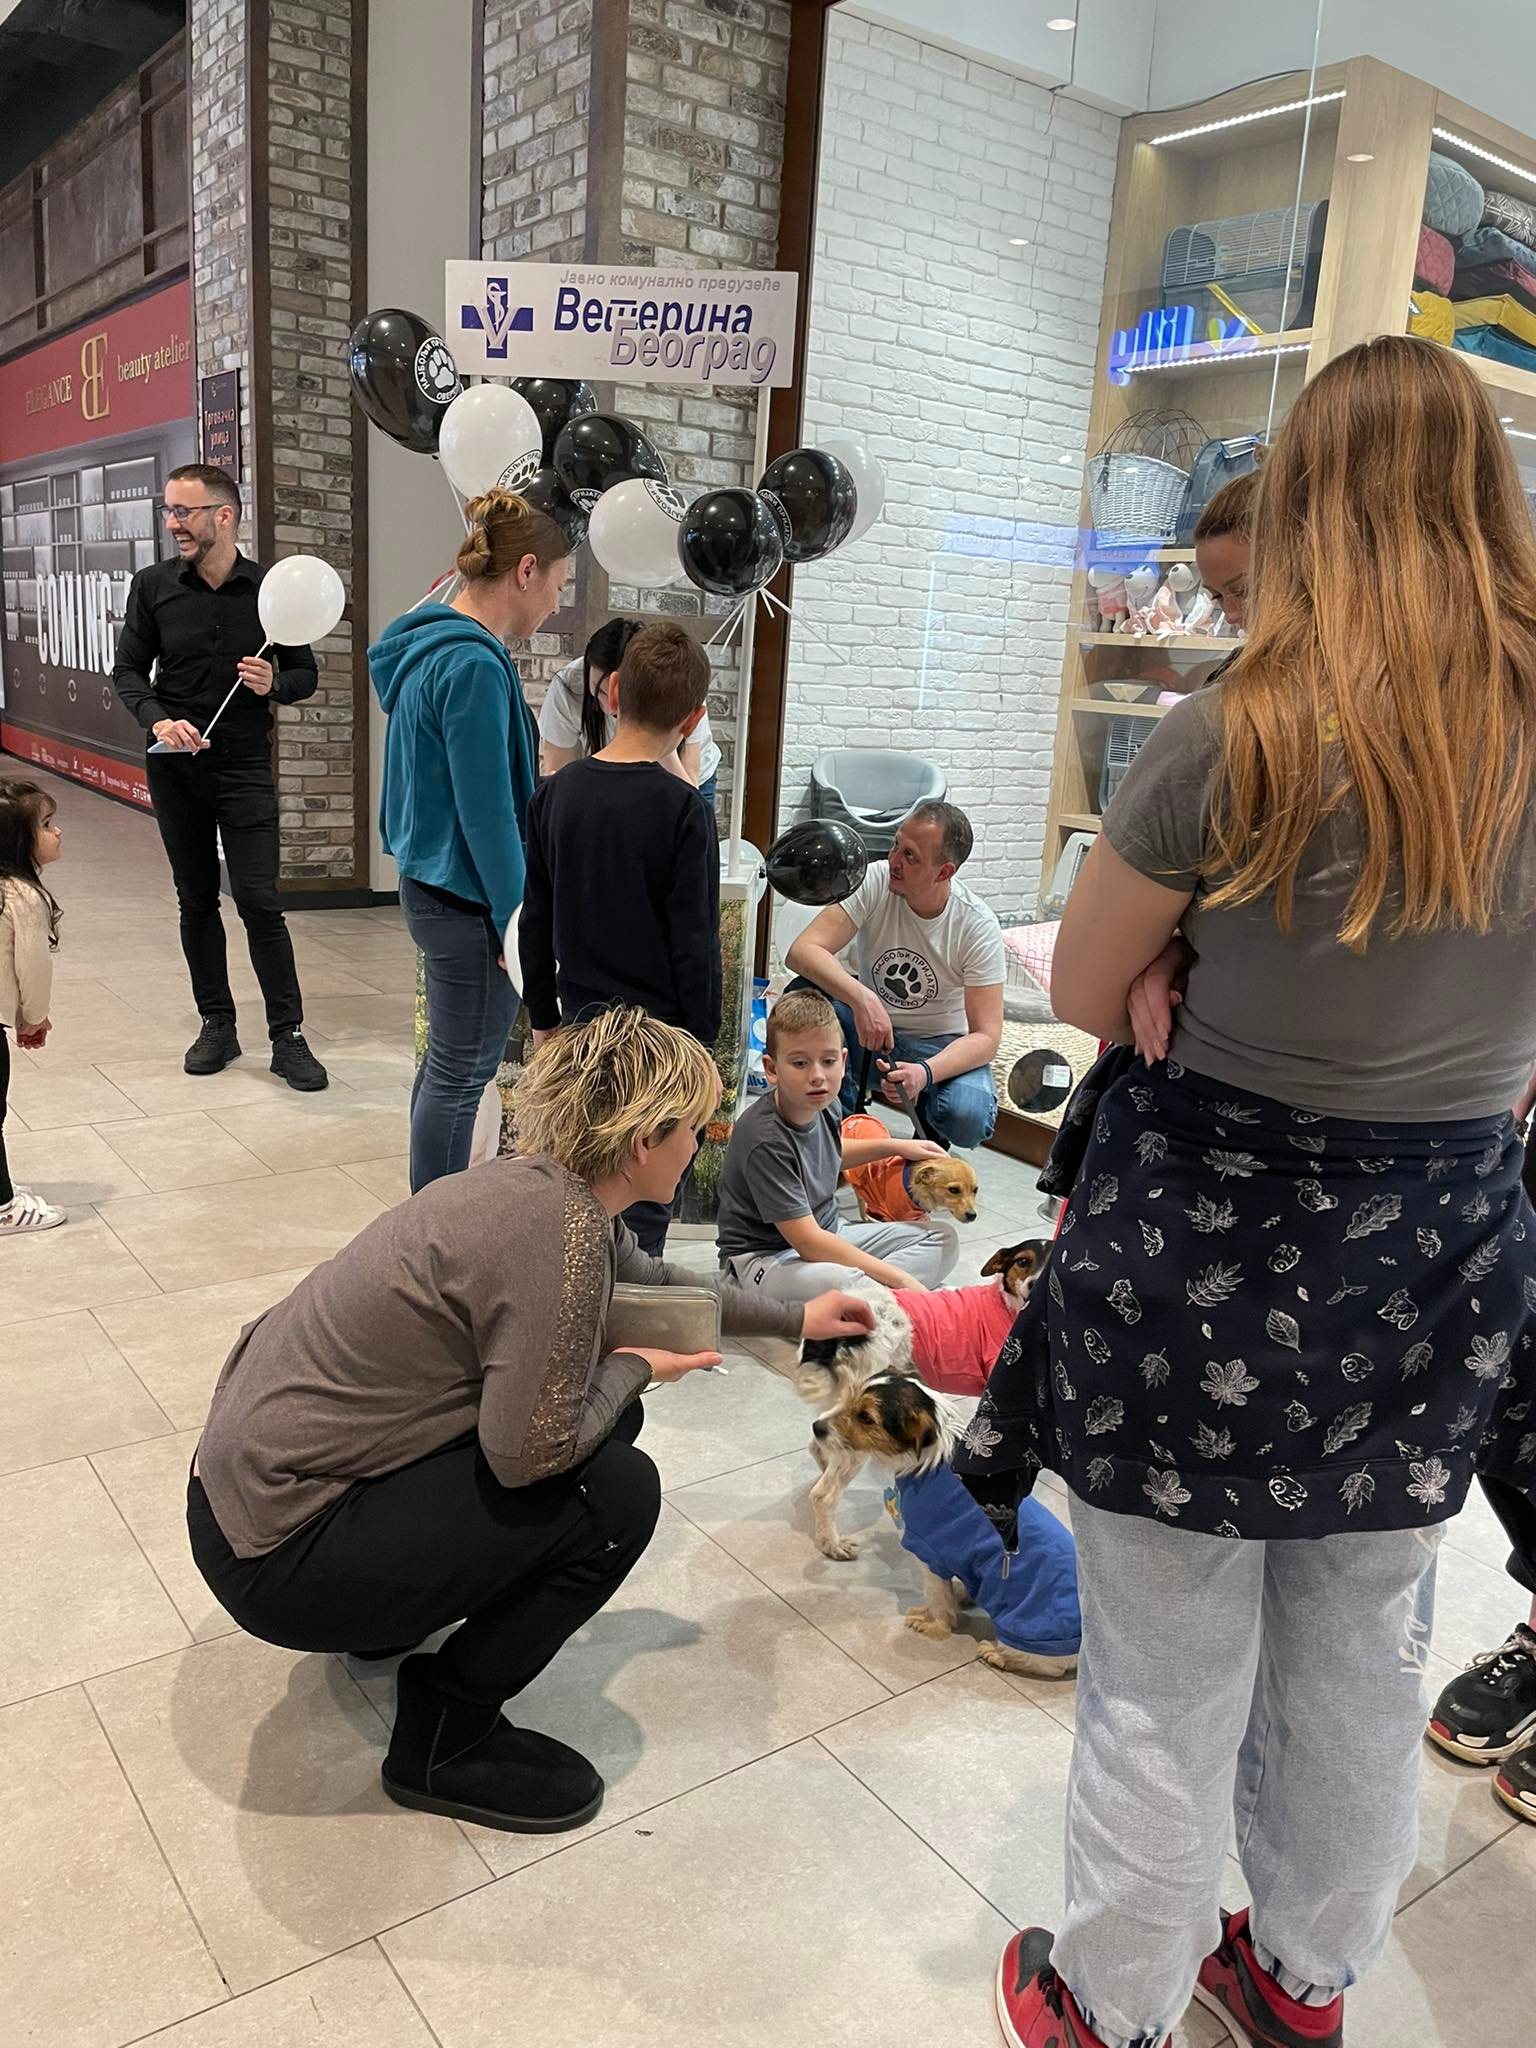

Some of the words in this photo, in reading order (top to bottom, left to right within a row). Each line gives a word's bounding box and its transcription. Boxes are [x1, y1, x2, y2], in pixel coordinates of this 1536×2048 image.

[560, 269, 606, 286] Јавно
[610, 273, 695, 291] комунално
[698, 278, 782, 292] предузеће
[25, 374, 73, 416] ELEGANCE
[117, 354, 152, 384] beauty
[154, 333, 192, 372] atelier
[610, 319, 777, 383] Београд
[36, 573, 115, 677] COMING
